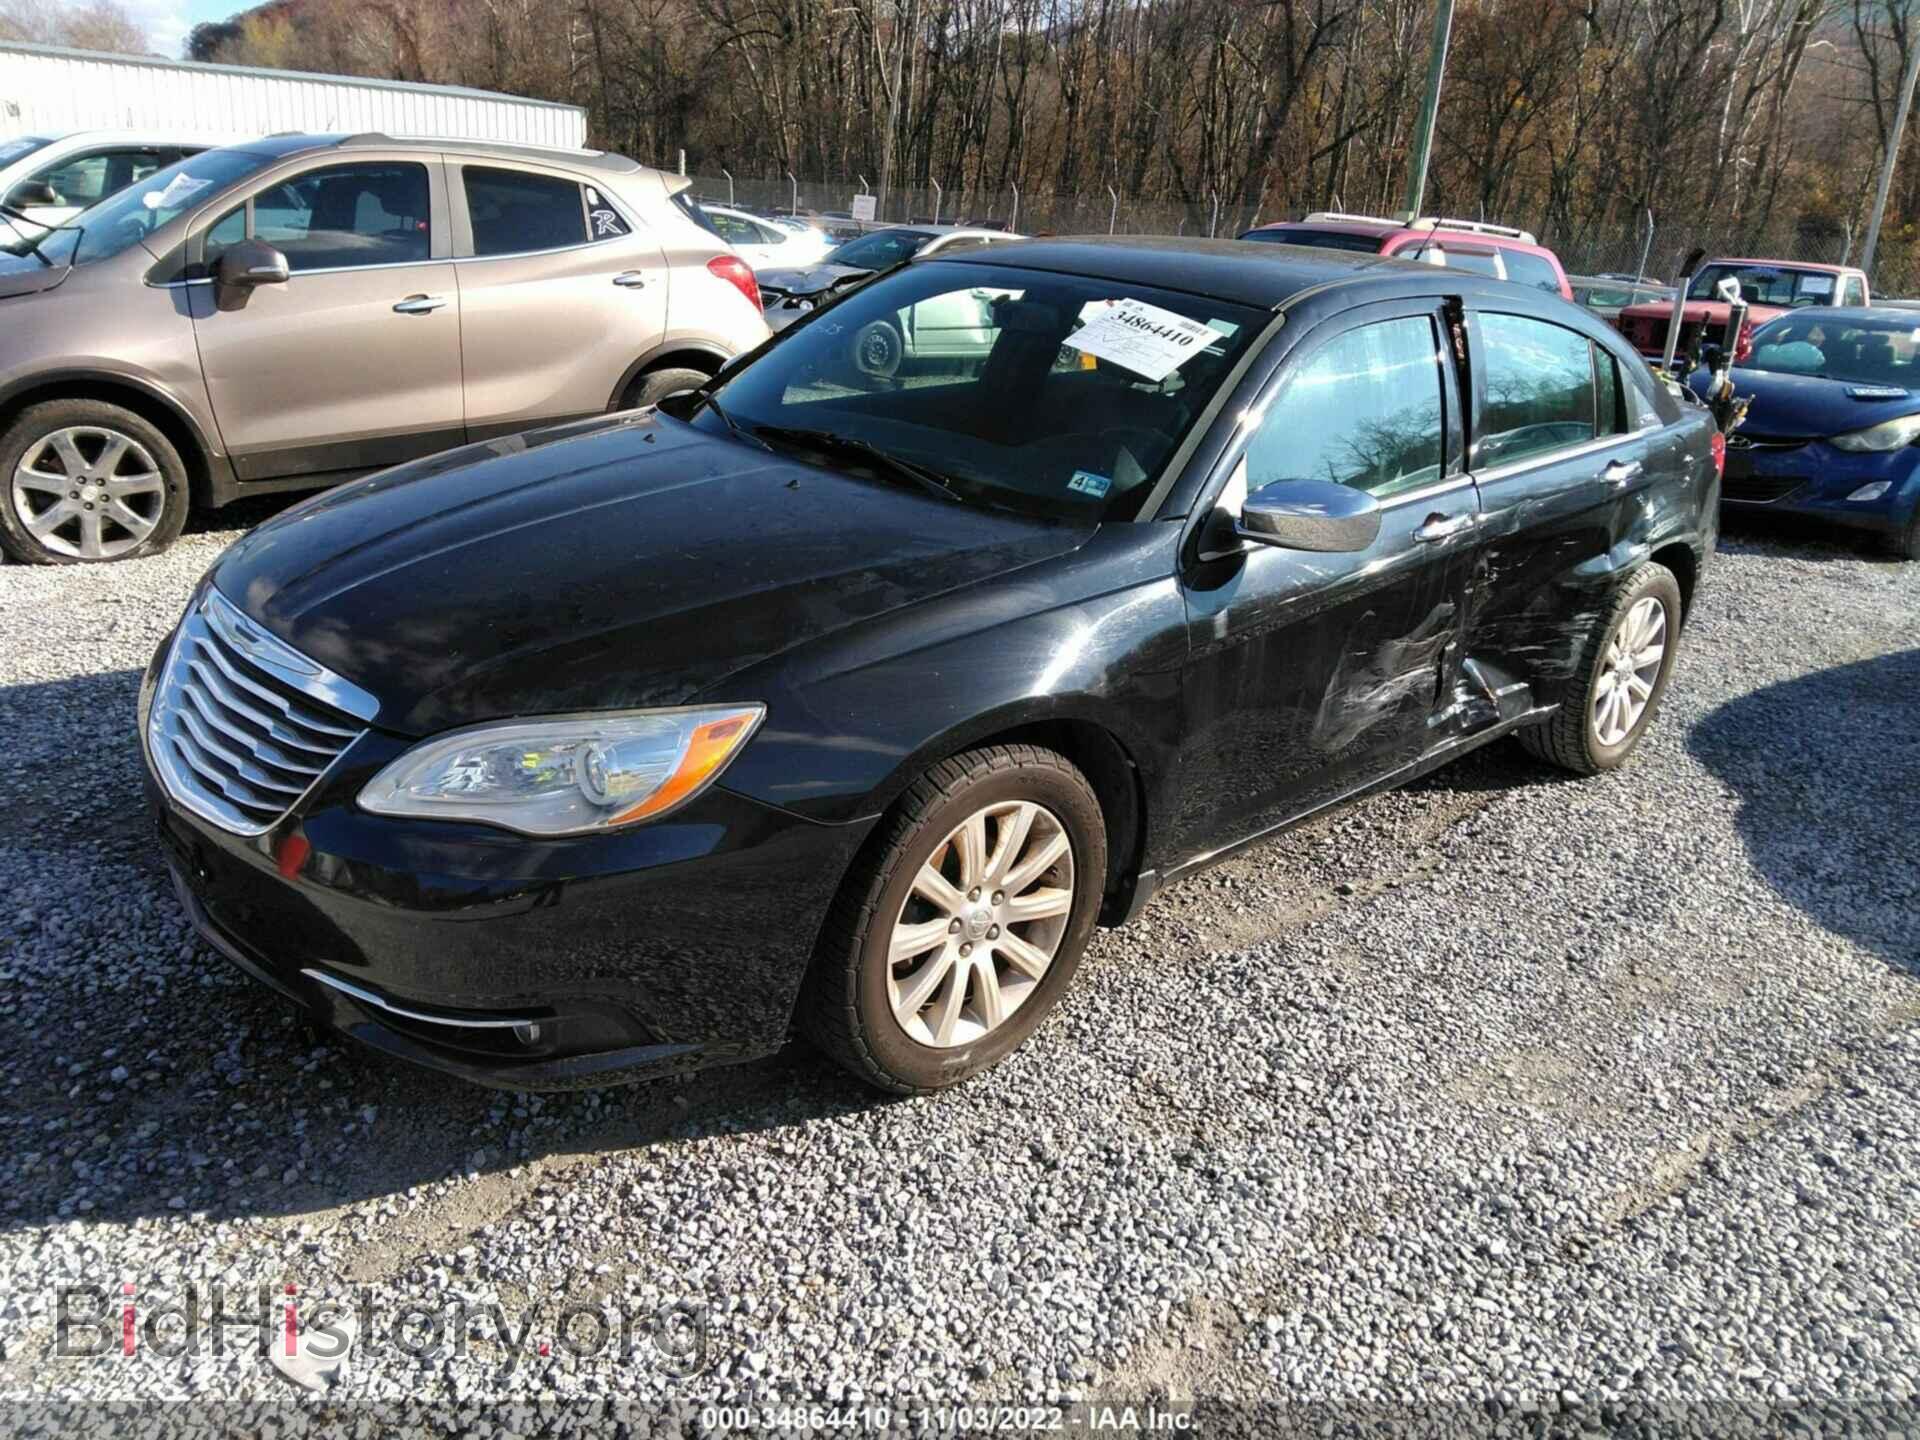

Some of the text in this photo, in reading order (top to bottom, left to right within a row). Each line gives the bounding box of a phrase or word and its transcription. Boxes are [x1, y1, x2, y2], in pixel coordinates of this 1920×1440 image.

[590, 209, 623, 236] R
[1110, 310, 1194, 346] 34864410
[1073, 475, 1086, 489] 4
